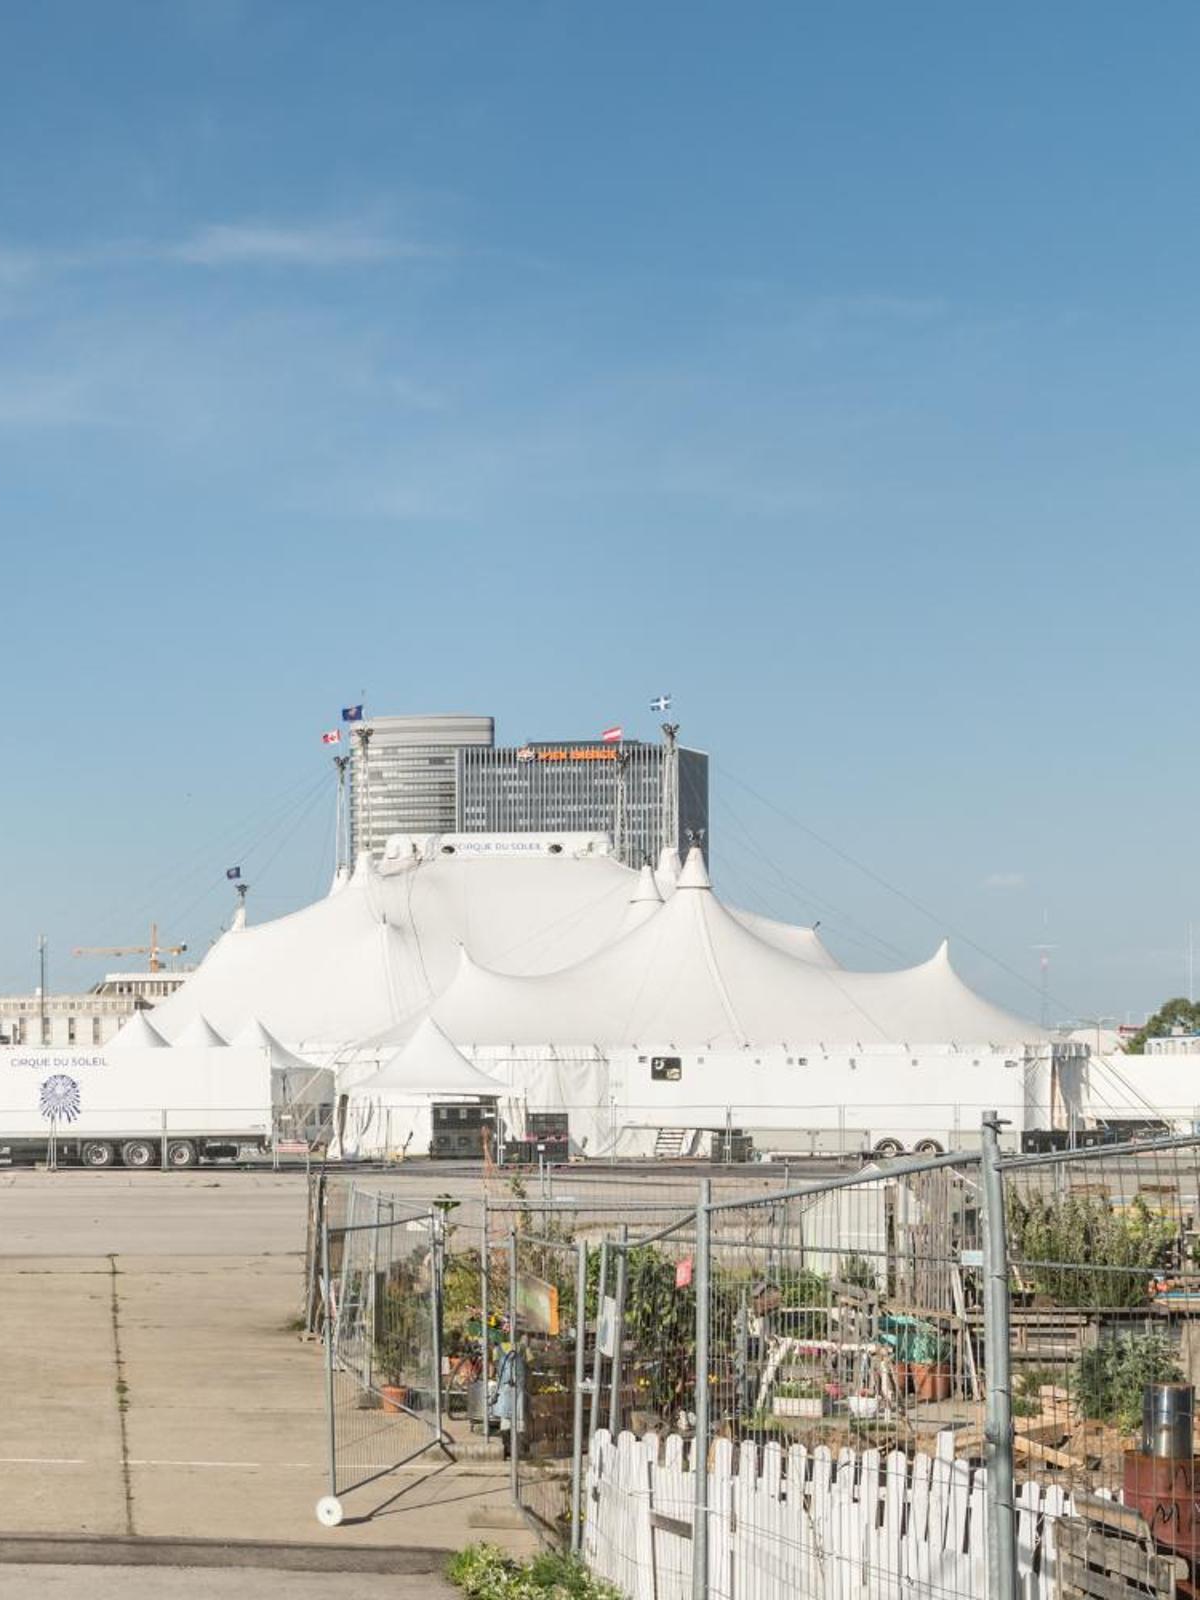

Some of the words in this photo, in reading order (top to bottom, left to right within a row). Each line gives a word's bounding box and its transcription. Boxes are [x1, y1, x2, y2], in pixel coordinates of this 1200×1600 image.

[10, 1057, 51, 1069] CIRQUE
[53, 1057, 69, 1067] DU
[71, 1057, 107, 1067] SOLEIL
